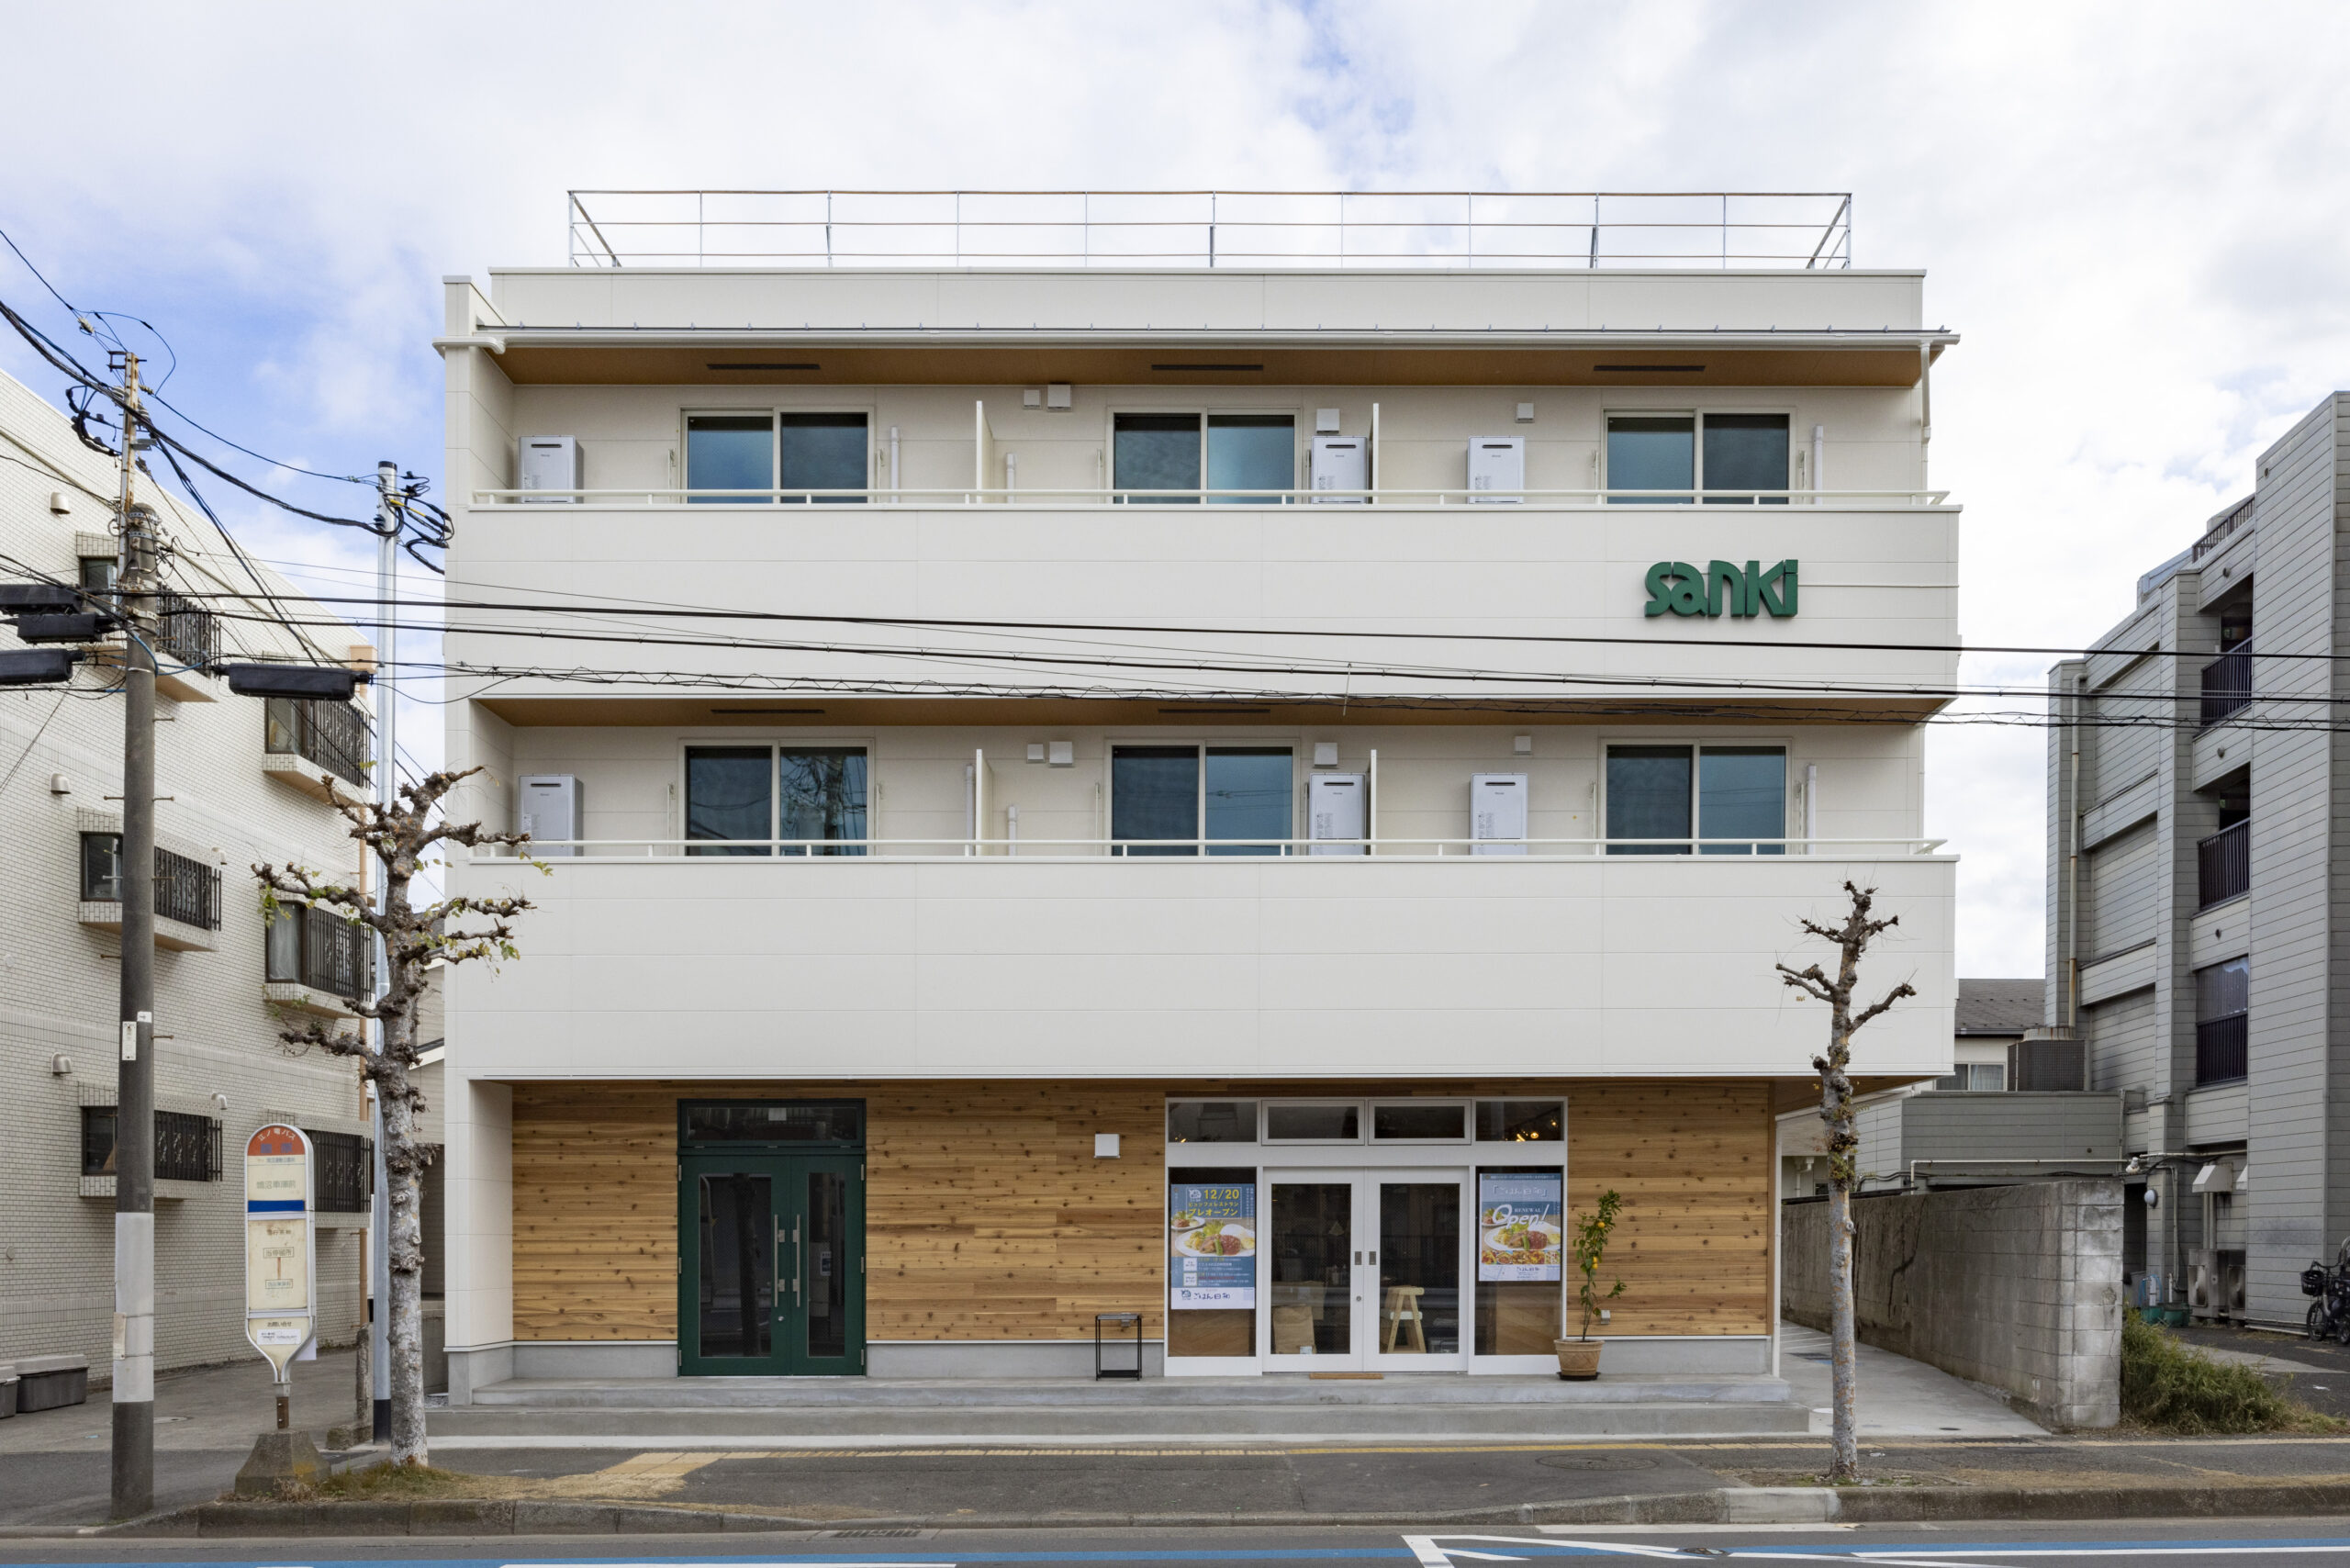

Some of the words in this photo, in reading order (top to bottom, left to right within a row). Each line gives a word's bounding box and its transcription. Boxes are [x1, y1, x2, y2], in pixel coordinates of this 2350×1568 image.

[1645, 559, 1798, 617] sanki
[258, 1127, 296, 1141] 江ノ電バス
[1204, 1189, 1239, 1200] 12/20
[1189, 1208, 1238, 1217] プレオープン
[1492, 1204, 1550, 1229] Open!
